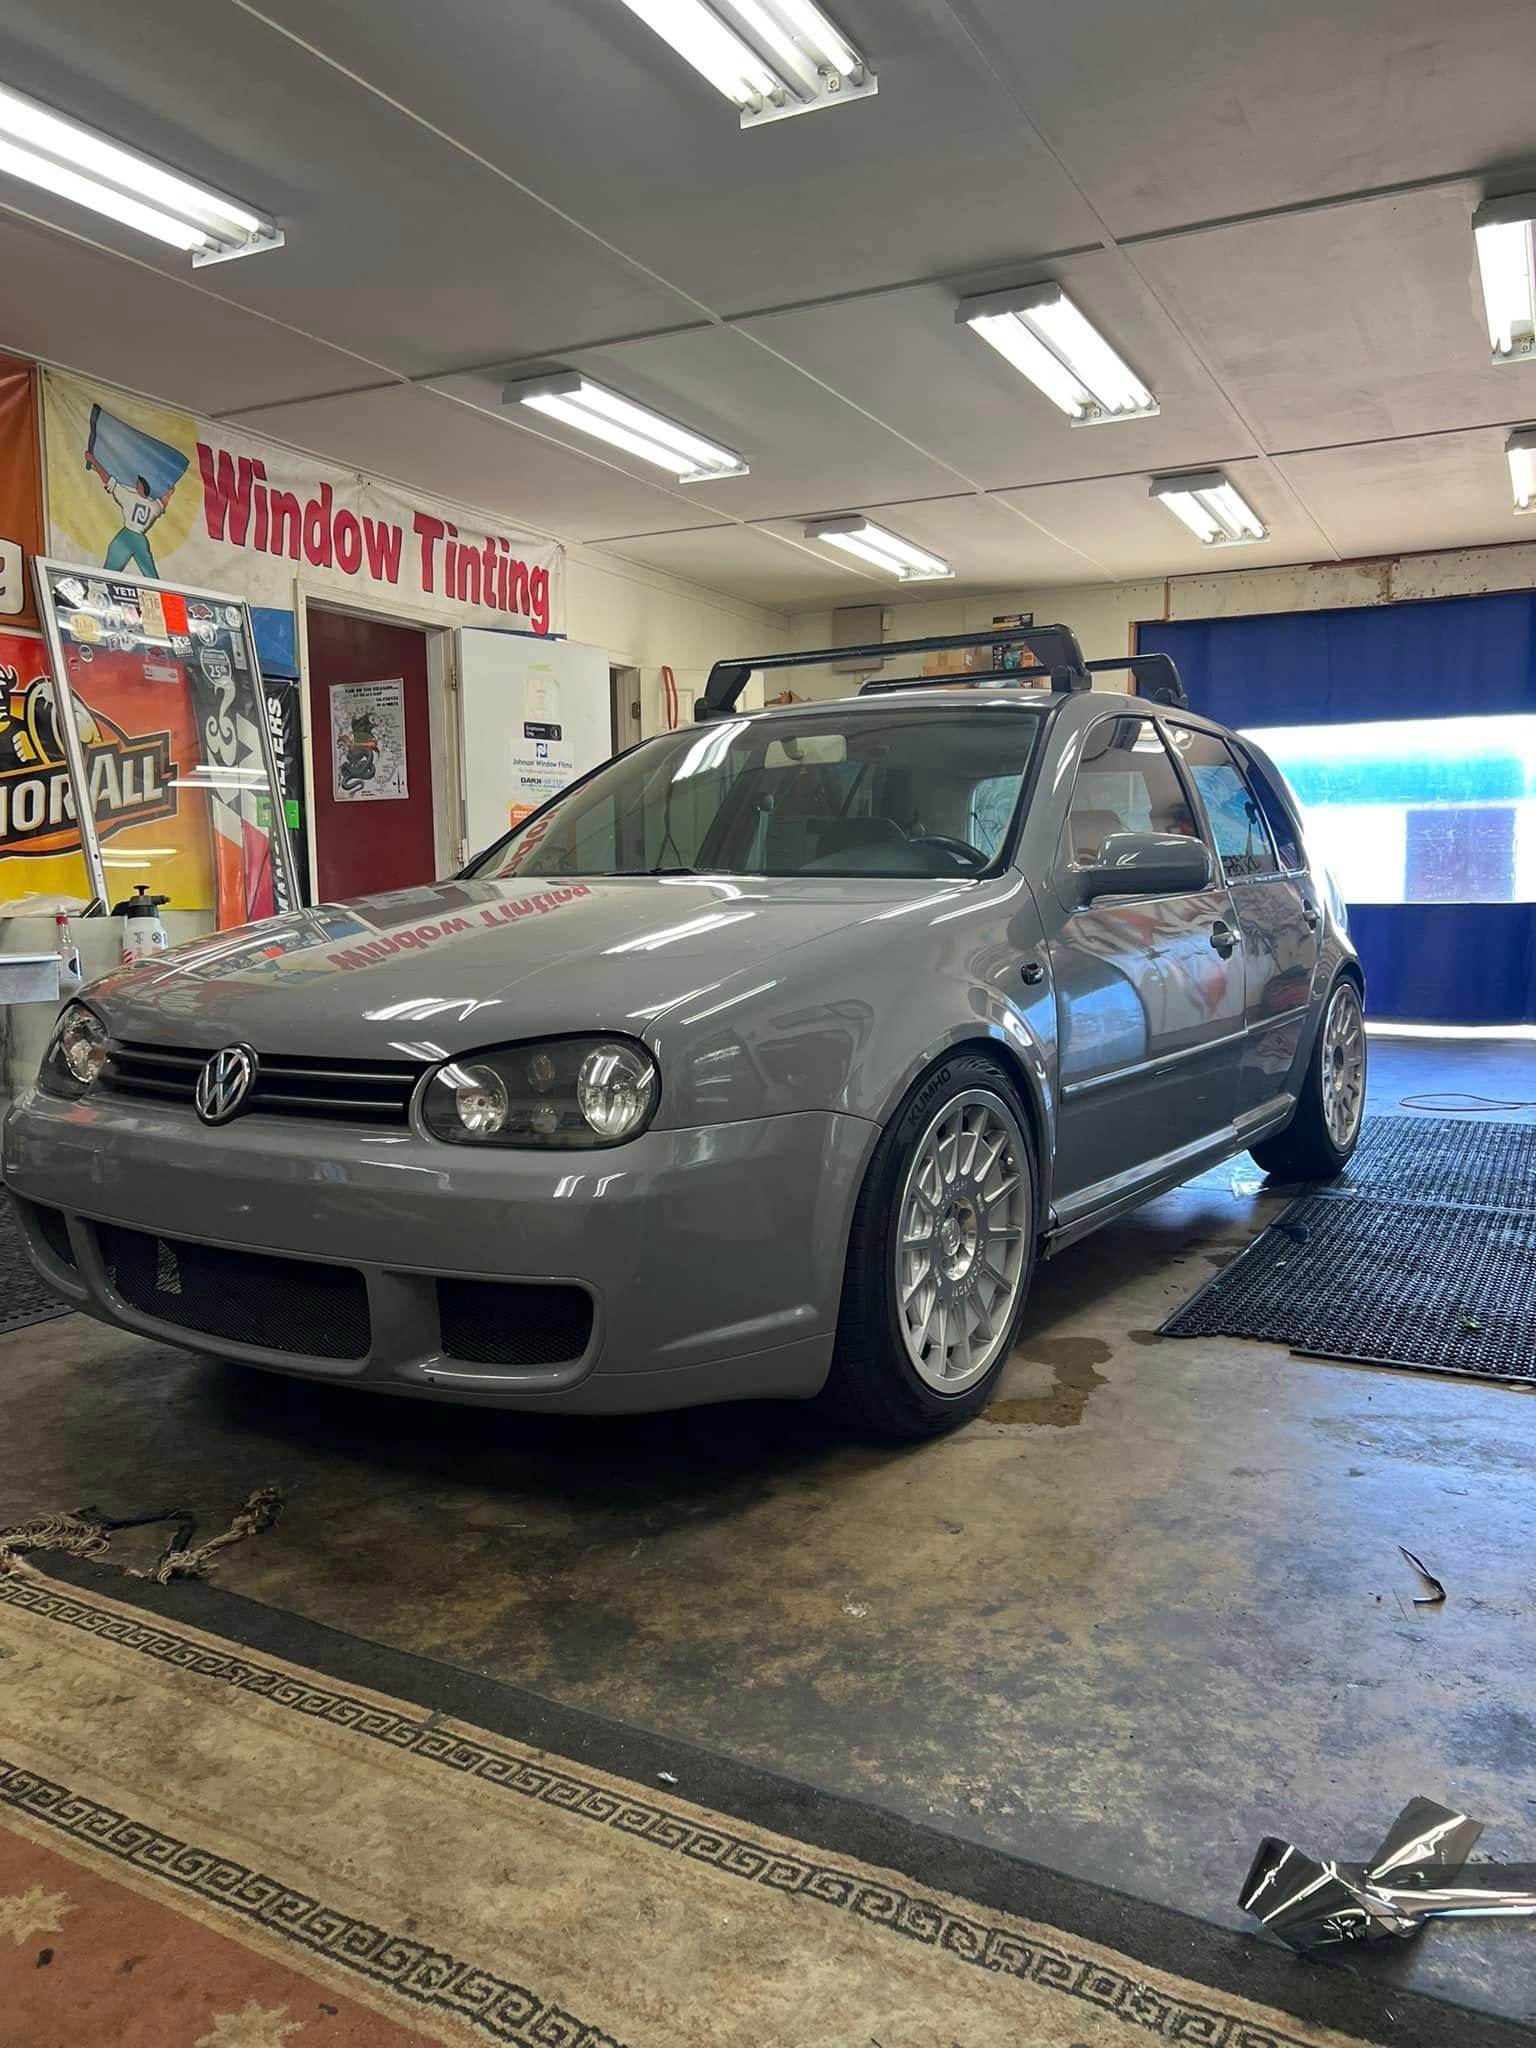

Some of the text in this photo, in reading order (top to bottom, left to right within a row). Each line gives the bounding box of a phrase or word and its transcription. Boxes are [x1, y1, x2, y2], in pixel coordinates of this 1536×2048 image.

[196, 442, 549, 636] Window Tinting
[907, 1067, 951, 1126] KUMHO
